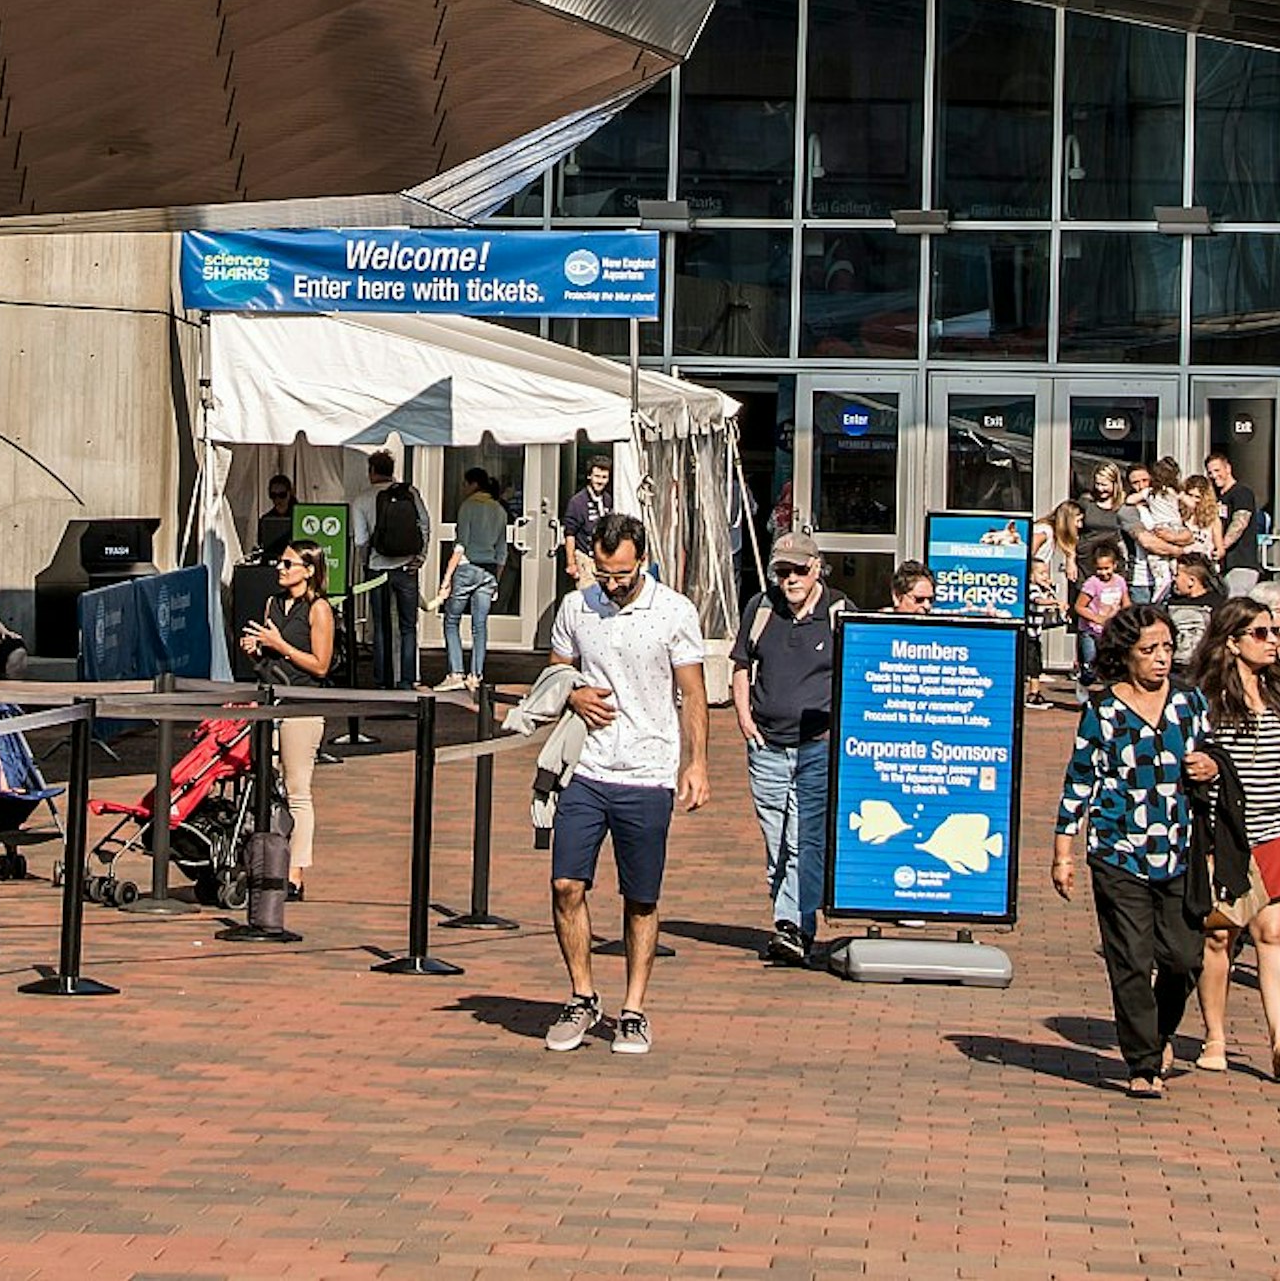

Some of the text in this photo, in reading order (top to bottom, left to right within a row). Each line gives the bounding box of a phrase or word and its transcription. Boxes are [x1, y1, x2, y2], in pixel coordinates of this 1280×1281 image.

[203, 252, 264, 267] science
[344, 239, 491, 272] Welcome!
[601, 257, 657, 272] New England
[201, 264, 270, 282] SHARKS
[601, 270, 646, 283] Aquarium
[293, 274, 546, 304] Enter here with tickets.
[564, 290, 657, 303] Protecting the blue planet
[842, 413, 869, 425] Enter
[983, 415, 1004, 427] Exit
[1105, 417, 1125, 430] Exit
[1235, 421, 1253, 433] Exit
[103, 545, 130, 555] TRASH
[936, 567, 1010, 586] science
[934, 584, 1018, 605] SHARKS
[891, 639, 969, 662] Members
[865, 671, 892, 682] Check
[922, 675, 941, 686] your
[883, 698, 974, 713] Joining or renewing?
[864, 711, 897, 721] Proceed
[924, 713, 963, 725] Aquarium
[845, 737, 1008, 764] Corporate Sponsors
